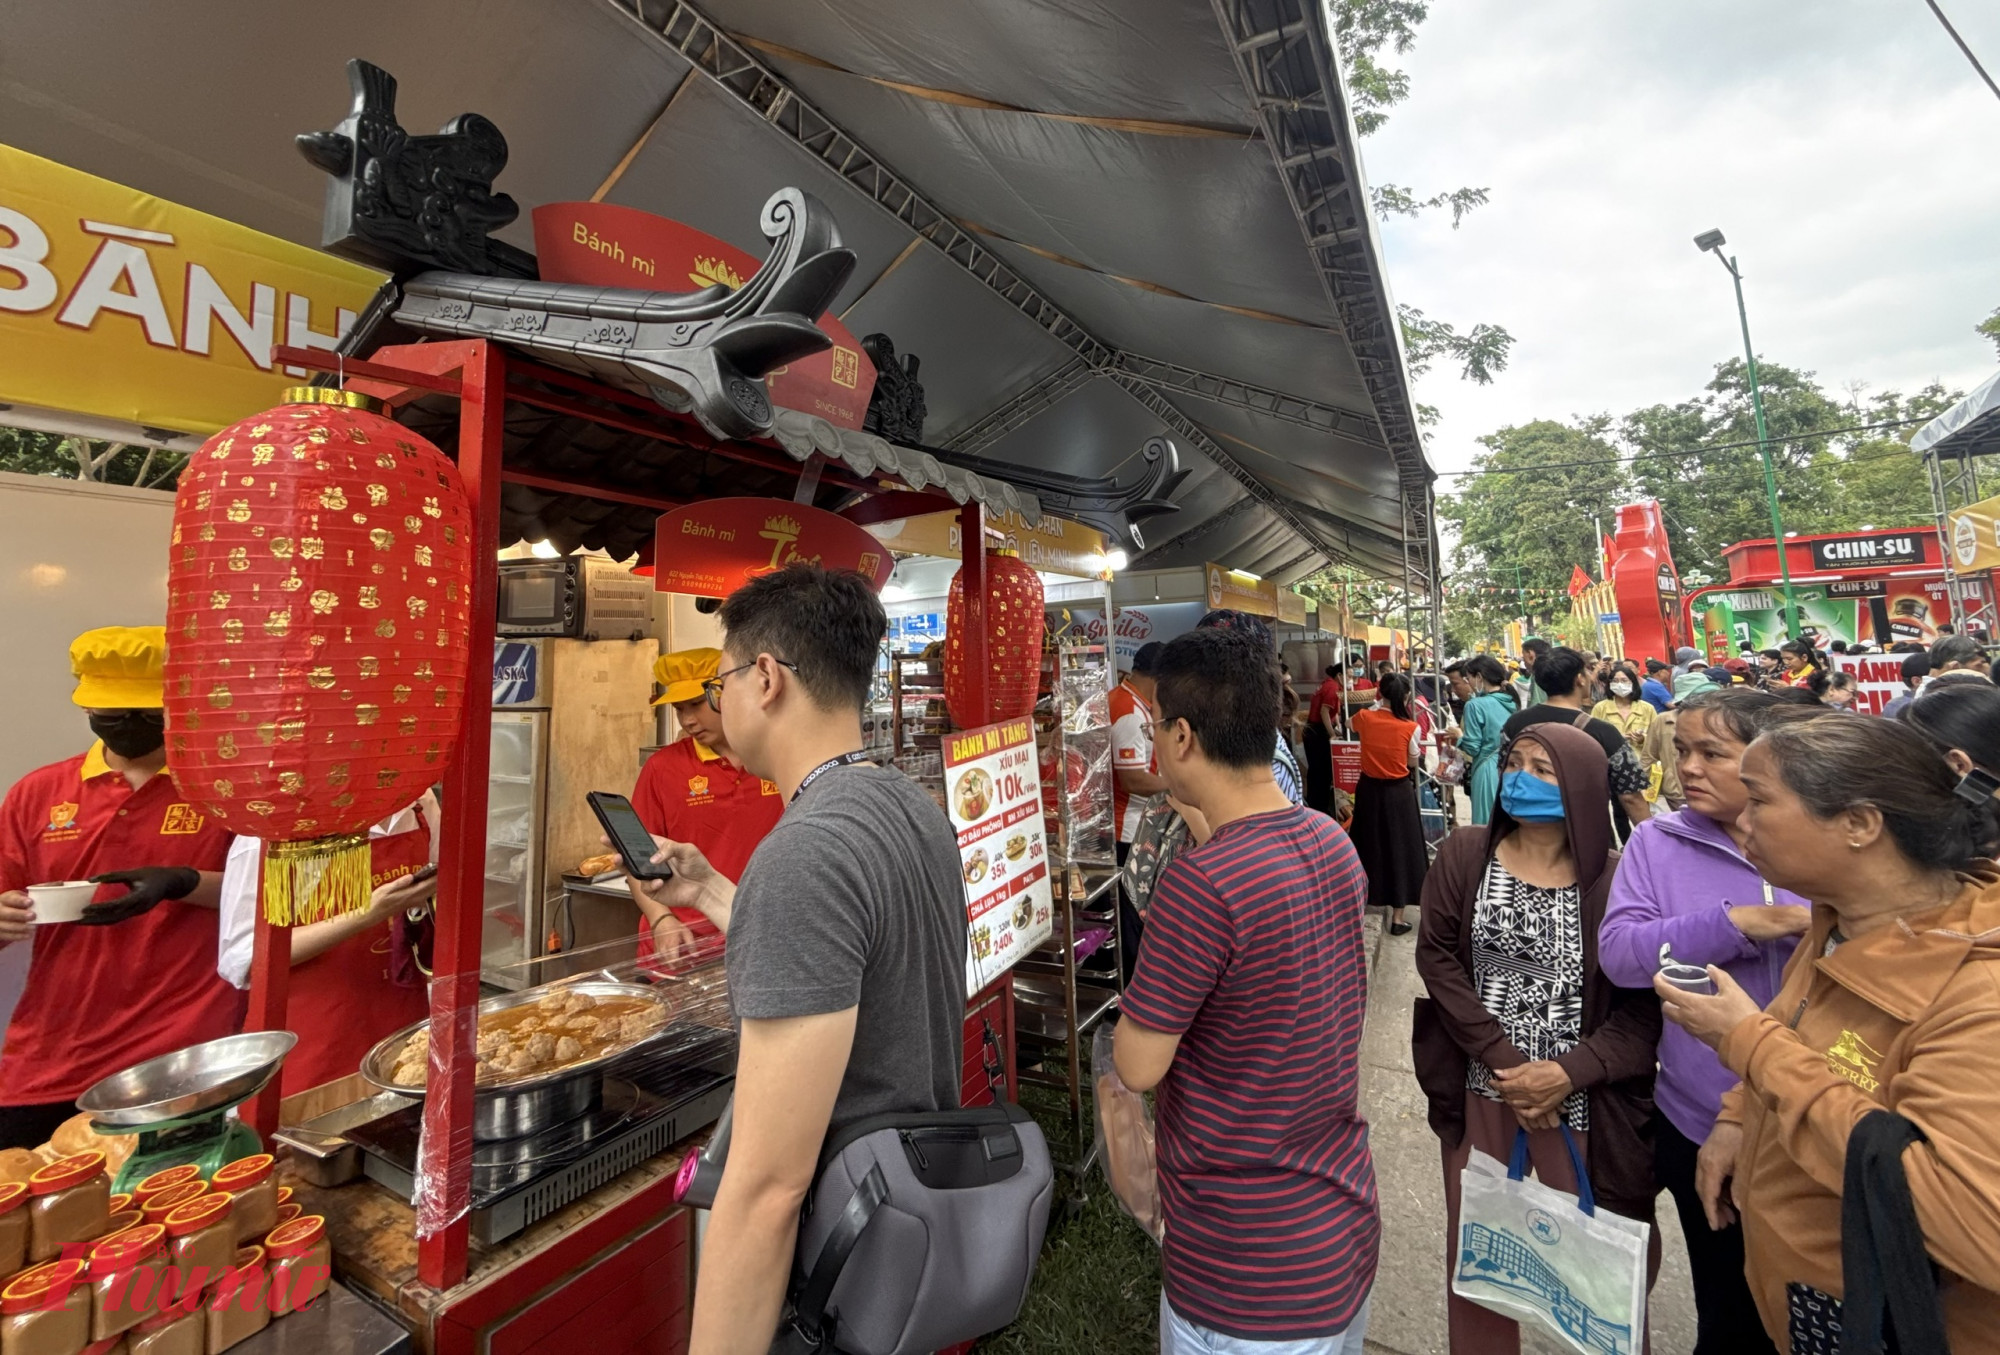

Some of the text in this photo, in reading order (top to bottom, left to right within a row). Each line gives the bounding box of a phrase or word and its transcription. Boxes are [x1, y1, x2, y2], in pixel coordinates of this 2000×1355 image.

[573, 221, 655, 277] Bánh mì
[815, 399, 837, 416] SINCE
[681, 519, 736, 542] Bánh mì
[1023, 538, 1045, 566] LIÊN
[1822, 538, 1913, 560] CHIN-SU
[1830, 581, 1880, 593] CHIN-SU
[1728, 592, 1774, 611] XANH
[1891, 623, 1920, 634] CHIN-SU
[1841, 658, 1903, 683] BÁNH
[952, 733, 985, 762] BÁNH
[985, 726, 1001, 751] MÌ
[999, 748, 1030, 771] XÍU MẠI
[1029, 841, 1044, 860] 30k
[371, 864, 410, 887] Bánh
[990, 861, 1008, 881] 35k
[1022, 872, 1035, 885] PATE
[1035, 904, 1050, 926] 25k
[993, 930, 1014, 956] 240k
